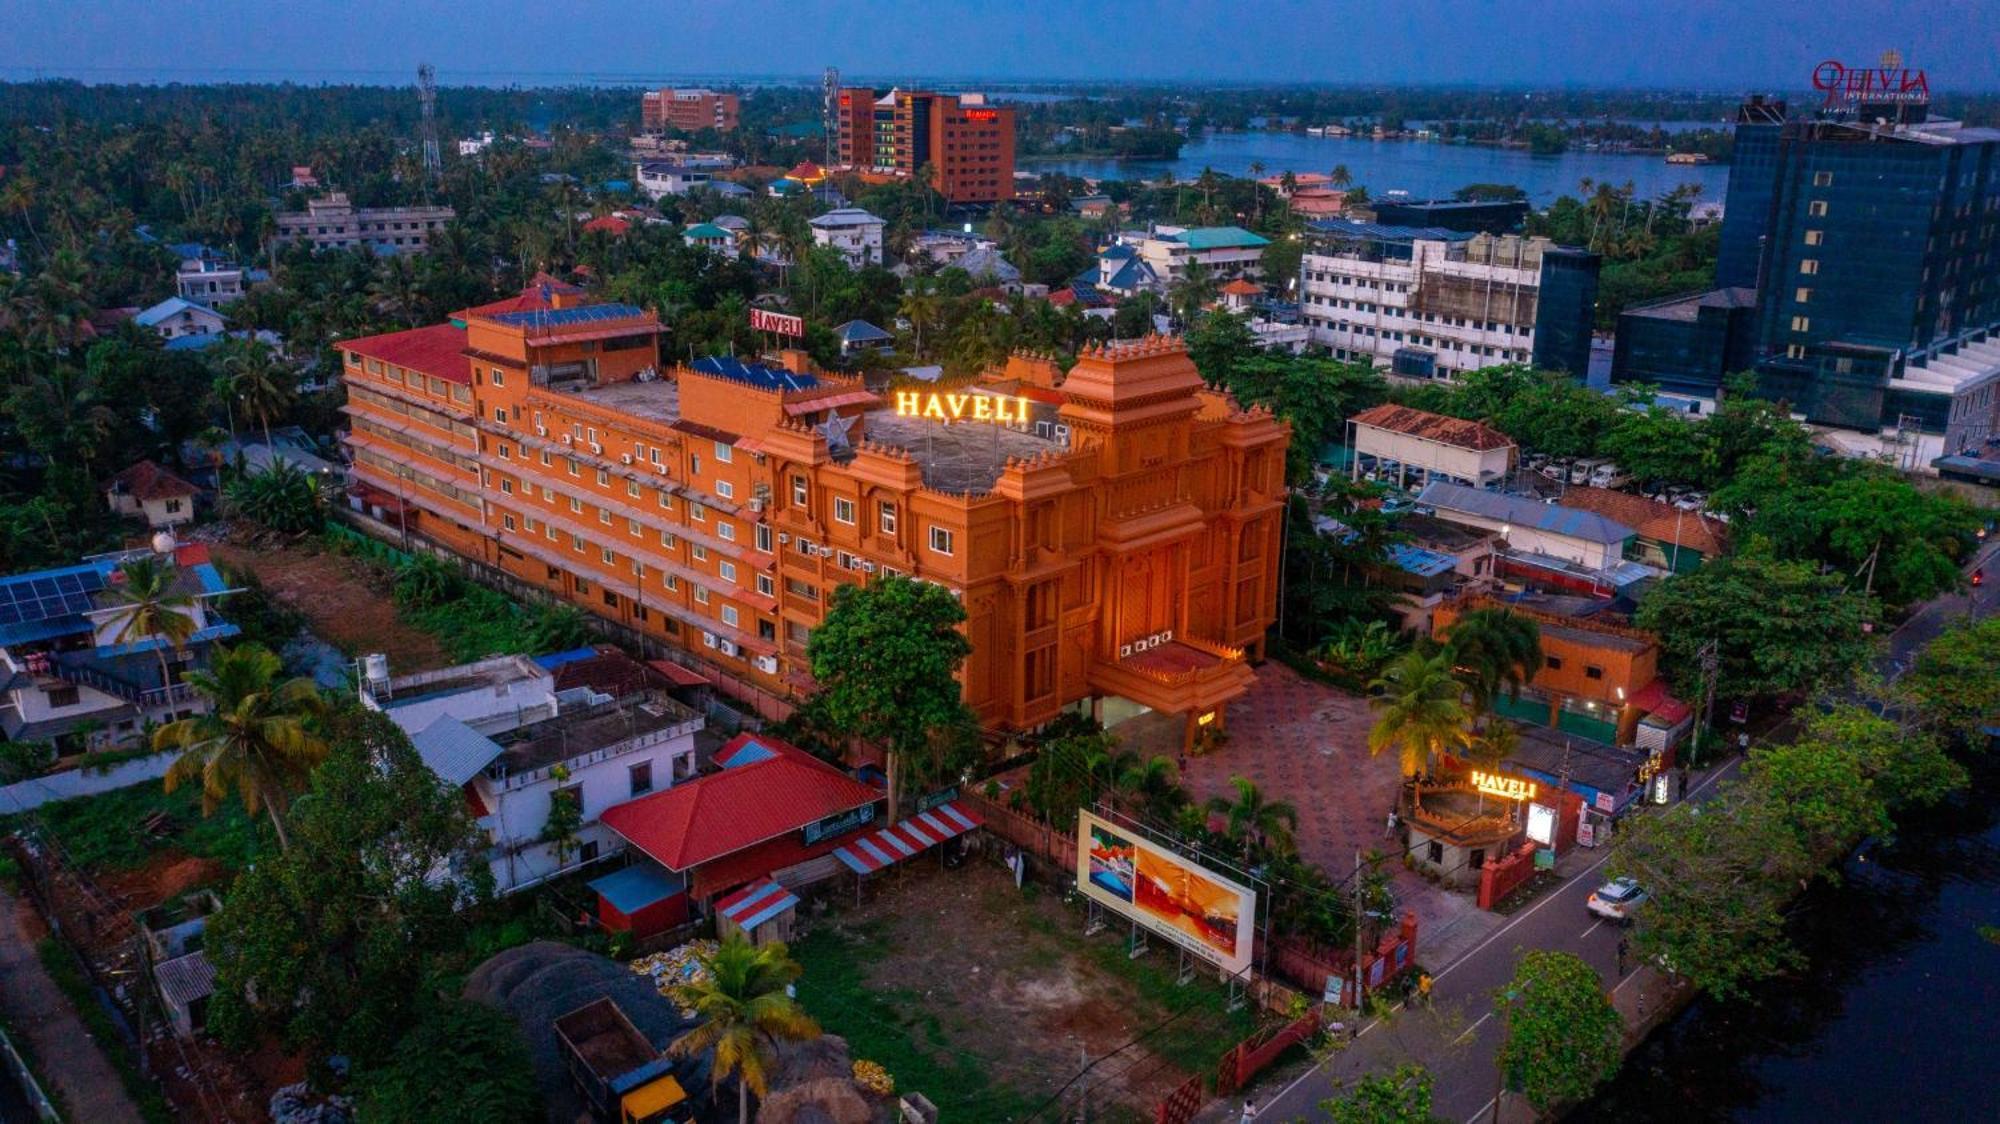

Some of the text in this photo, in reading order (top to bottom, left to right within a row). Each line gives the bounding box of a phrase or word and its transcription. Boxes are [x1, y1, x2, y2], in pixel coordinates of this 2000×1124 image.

[751, 310, 802, 336] HAVELI
[897, 391, 1028, 421] HAVELI
[1471, 771, 1537, 798] HAVELI
